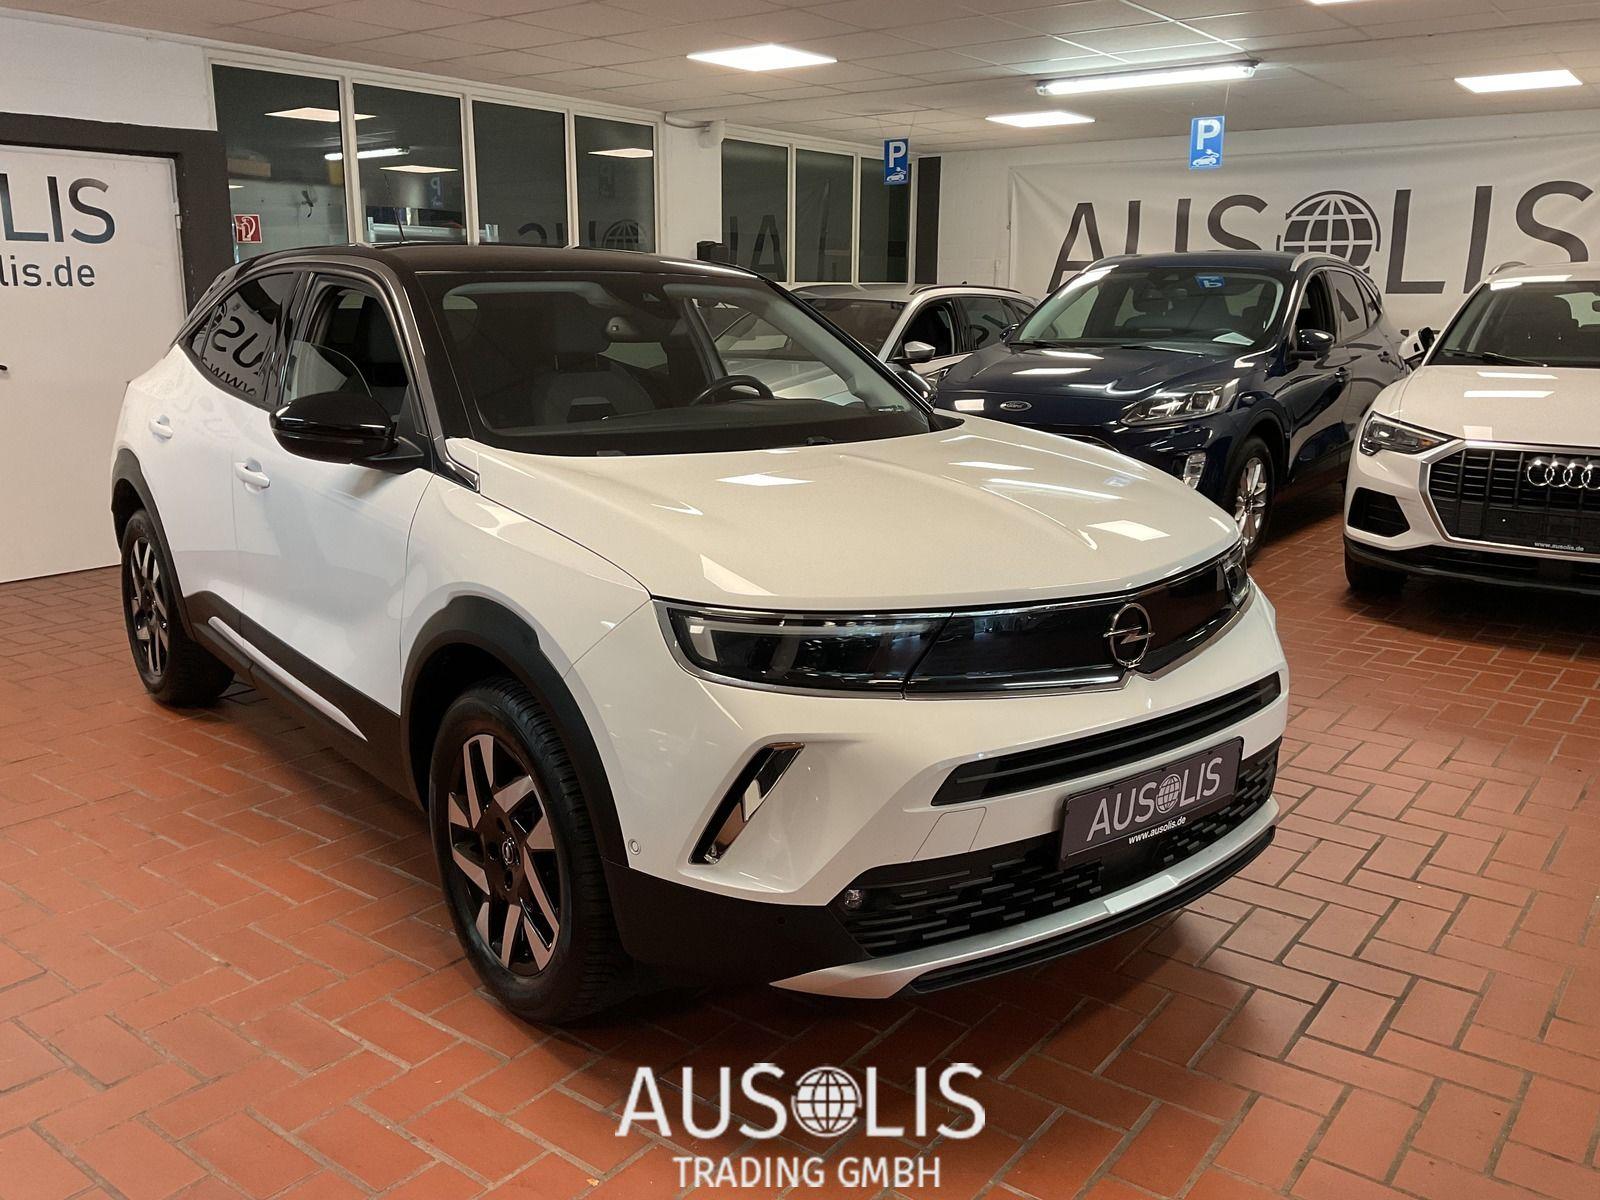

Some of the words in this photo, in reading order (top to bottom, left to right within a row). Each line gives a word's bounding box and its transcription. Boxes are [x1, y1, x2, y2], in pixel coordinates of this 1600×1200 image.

[1196, 119, 1221, 150] P
[888, 141, 907, 168] P
[1128, 815, 1187, 845] www.ausolis.de
